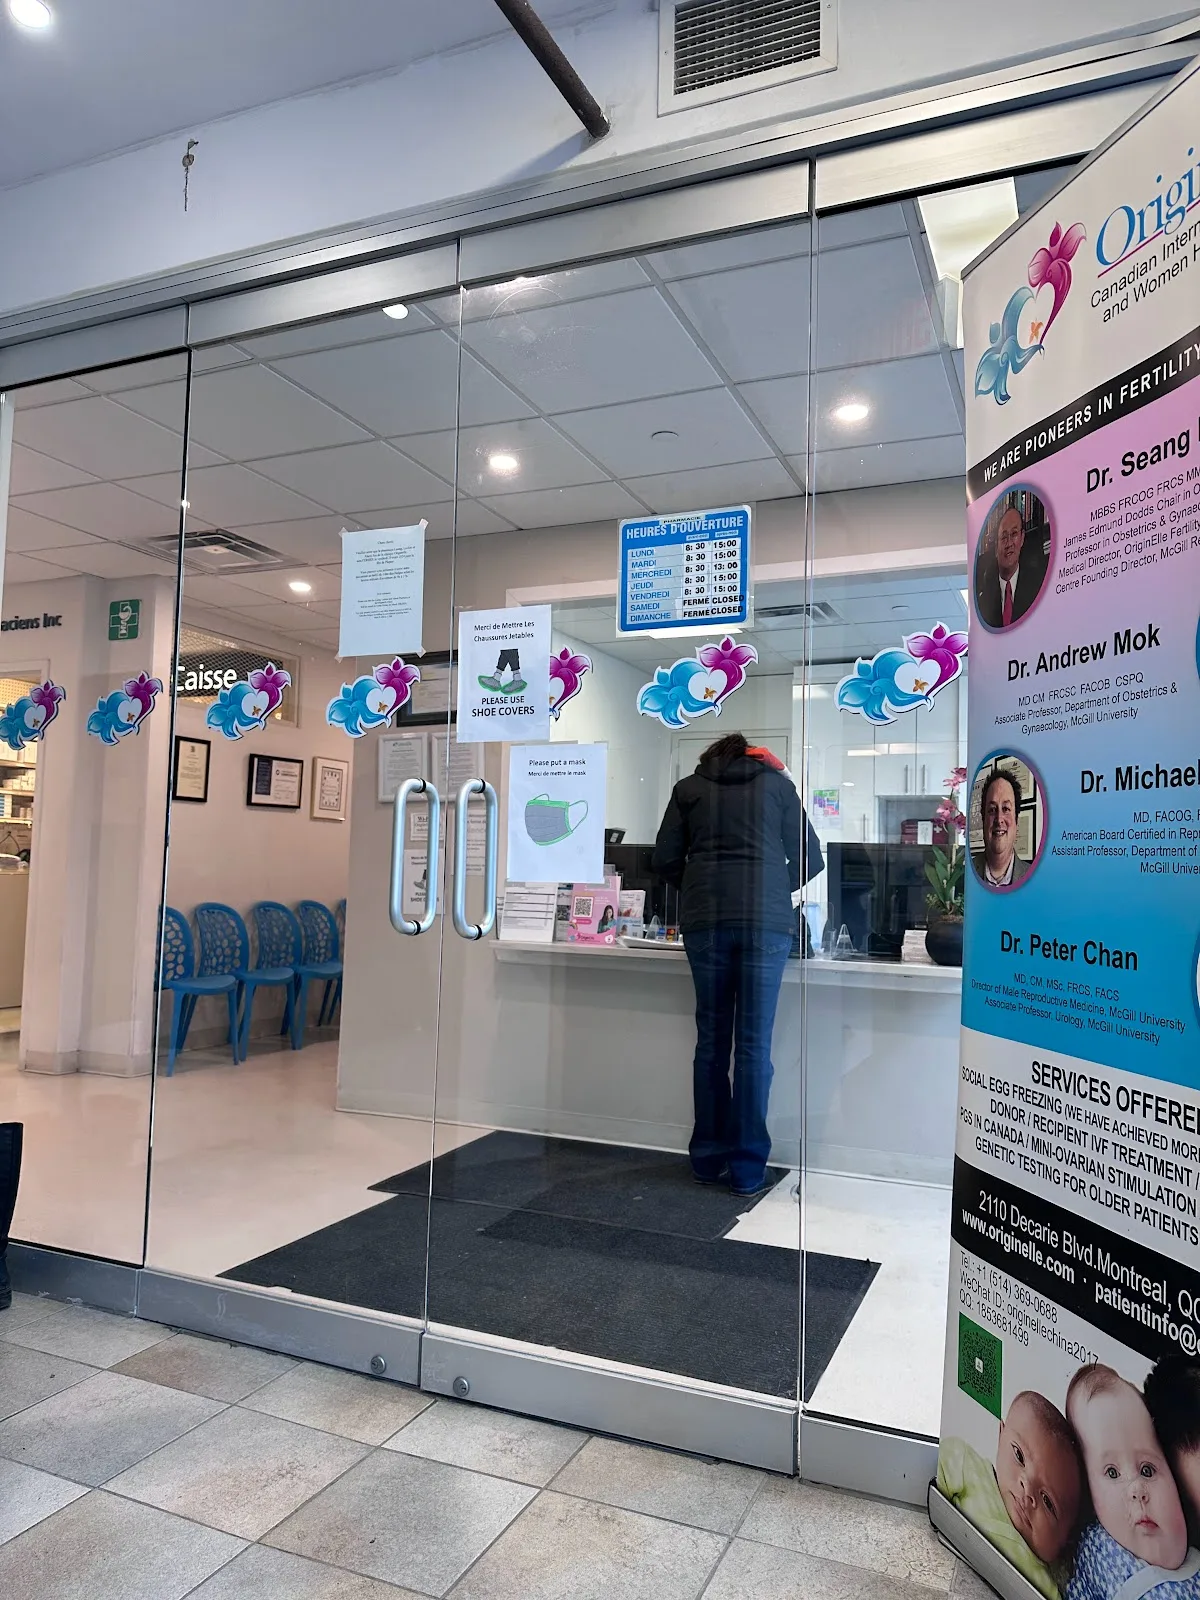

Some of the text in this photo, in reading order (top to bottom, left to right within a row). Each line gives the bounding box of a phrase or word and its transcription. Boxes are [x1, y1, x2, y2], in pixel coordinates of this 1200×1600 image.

[1096, 147, 1200, 266] Origi
[1091, 255, 1157, 308] Canadian
[1103, 255, 1188, 323] and Women
[984, 343, 1200, 482] WE ARE PIONEERS IN FERTILITY
[1087, 467, 1113, 494] Dr.
[1121, 428, 1190, 477] Seang
[1090, 473, 1184, 522] MBBS FRCOG FRCS
[626, 515, 744, 539] HEURES D'OUVERTURE
[1063, 493, 1180, 549] James Edmund Dodds Chair
[1065, 520, 1157, 562] Professor Obstetrics
[631, 549, 655, 558] LUNDI
[631, 560, 657, 569] MARDI
[1055, 537, 1188, 595] Centre Founding Director, McGill
[1058, 560, 1086, 579] Medical
[1088, 549, 1122, 568] Director,
[1124, 532, 1168, 555] OriginElle
[630, 582, 654, 590] JEUDI
[631, 569, 672, 580] MERCREDI
[630, 591, 670, 601] VENDREDI
[630, 594, 745, 612] SAMEDI FERMÉ CLOSED
[630, 605, 743, 622] DIMANCHE FERMÉ CLOSED
[43, 613, 62, 628] Inc
[473, 632, 534, 642] Chaussures Jetables
[1008, 623, 1161, 682] Dr. Andrew Mok
[172, 664, 237, 691] Caisse
[1018, 671, 1144, 707] MD CM FRCSC FACOB CSPQ
[471, 705, 535, 717] SHOE COVERS
[481, 695, 525, 705] PLEASE USE
[994, 685, 1168, 725] Associate Professor, Department of Obstetrics
[1021, 706, 1139, 735] Gynaecology, McGill University
[1081, 770, 1107, 793] Dr.
[1061, 828, 1177, 841] American Board Certified in
[1133, 811, 1152, 824] MD,
[1155, 809, 1194, 823] FACOG,
[1051, 844, 1198, 859] Assistant Professor, Department of
[1140, 861, 1170, 874] McGill
[1000, 930, 1138, 971] Dr. Peter Chan
[971, 978, 1186, 1034] Director of Male Reproductive Medicine, McGill University
[1014, 972, 1120, 1002] MD, CM, MSc, FRCS, FACS
[984, 996, 1160, 1046] Associate Professor, Urology, McGill University
[961, 1065, 1168, 1151] SOCIAL EGG FREEZING (WE HAVE ACHIEVED
[1031, 1060, 1200, 1136] SERVICES OFFERE
[990, 1098, 1193, 1187] DONOR RECIPIENT IVF TREATMENT
[974, 1113, 982, 1130] IN
[983, 1118, 1025, 1148] CANADA
[1031, 1135, 1105, 1181] MINI-OVARIAN
[1108, 1166, 1197, 1218] STIMULATION
[975, 1136, 1199, 1246] GENETIC TESTING FOR OLDER PATIENTS
[979, 1190, 1007, 1222] 2110
[1010, 1204, 1059, 1249] Decarie
[962, 1208, 1075, 1285] www.originelle.com
[976, 1263, 987, 1280] +1
[989, 1270, 1012, 1299] (514)
[1013, 1284, 1058, 1324] 369-0688
[959, 1288, 1029, 1347] QQ: 1853681499
[960, 1268, 1099, 1370] WeChat ID: originellechina2017
